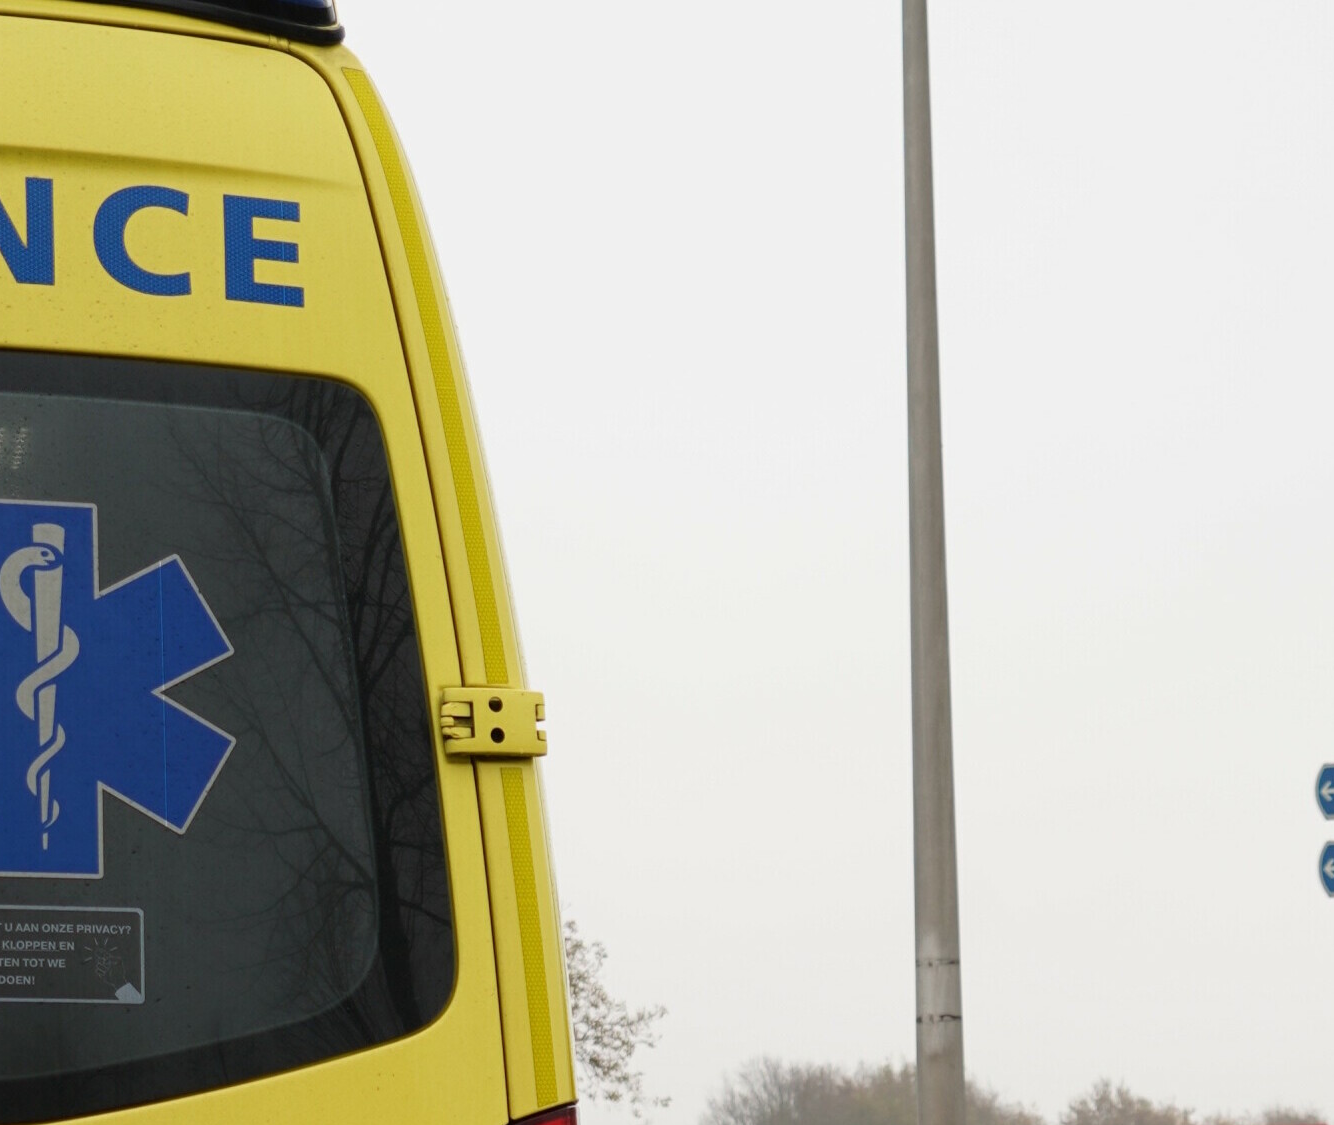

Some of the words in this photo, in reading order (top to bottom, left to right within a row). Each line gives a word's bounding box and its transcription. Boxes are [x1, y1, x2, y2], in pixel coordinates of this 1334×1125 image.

[5, 923, 13, 933] U
[15, 923, 39, 933] AAN
[41, 923, 74, 933] ONZE
[76, 924, 132, 935] PRIVACY?
[2, 940, 56, 951] KLOPPEN
[59, 941, 75, 951] EN
[23, 958, 45, 968] TOT
[47, 958, 66, 968] WE
